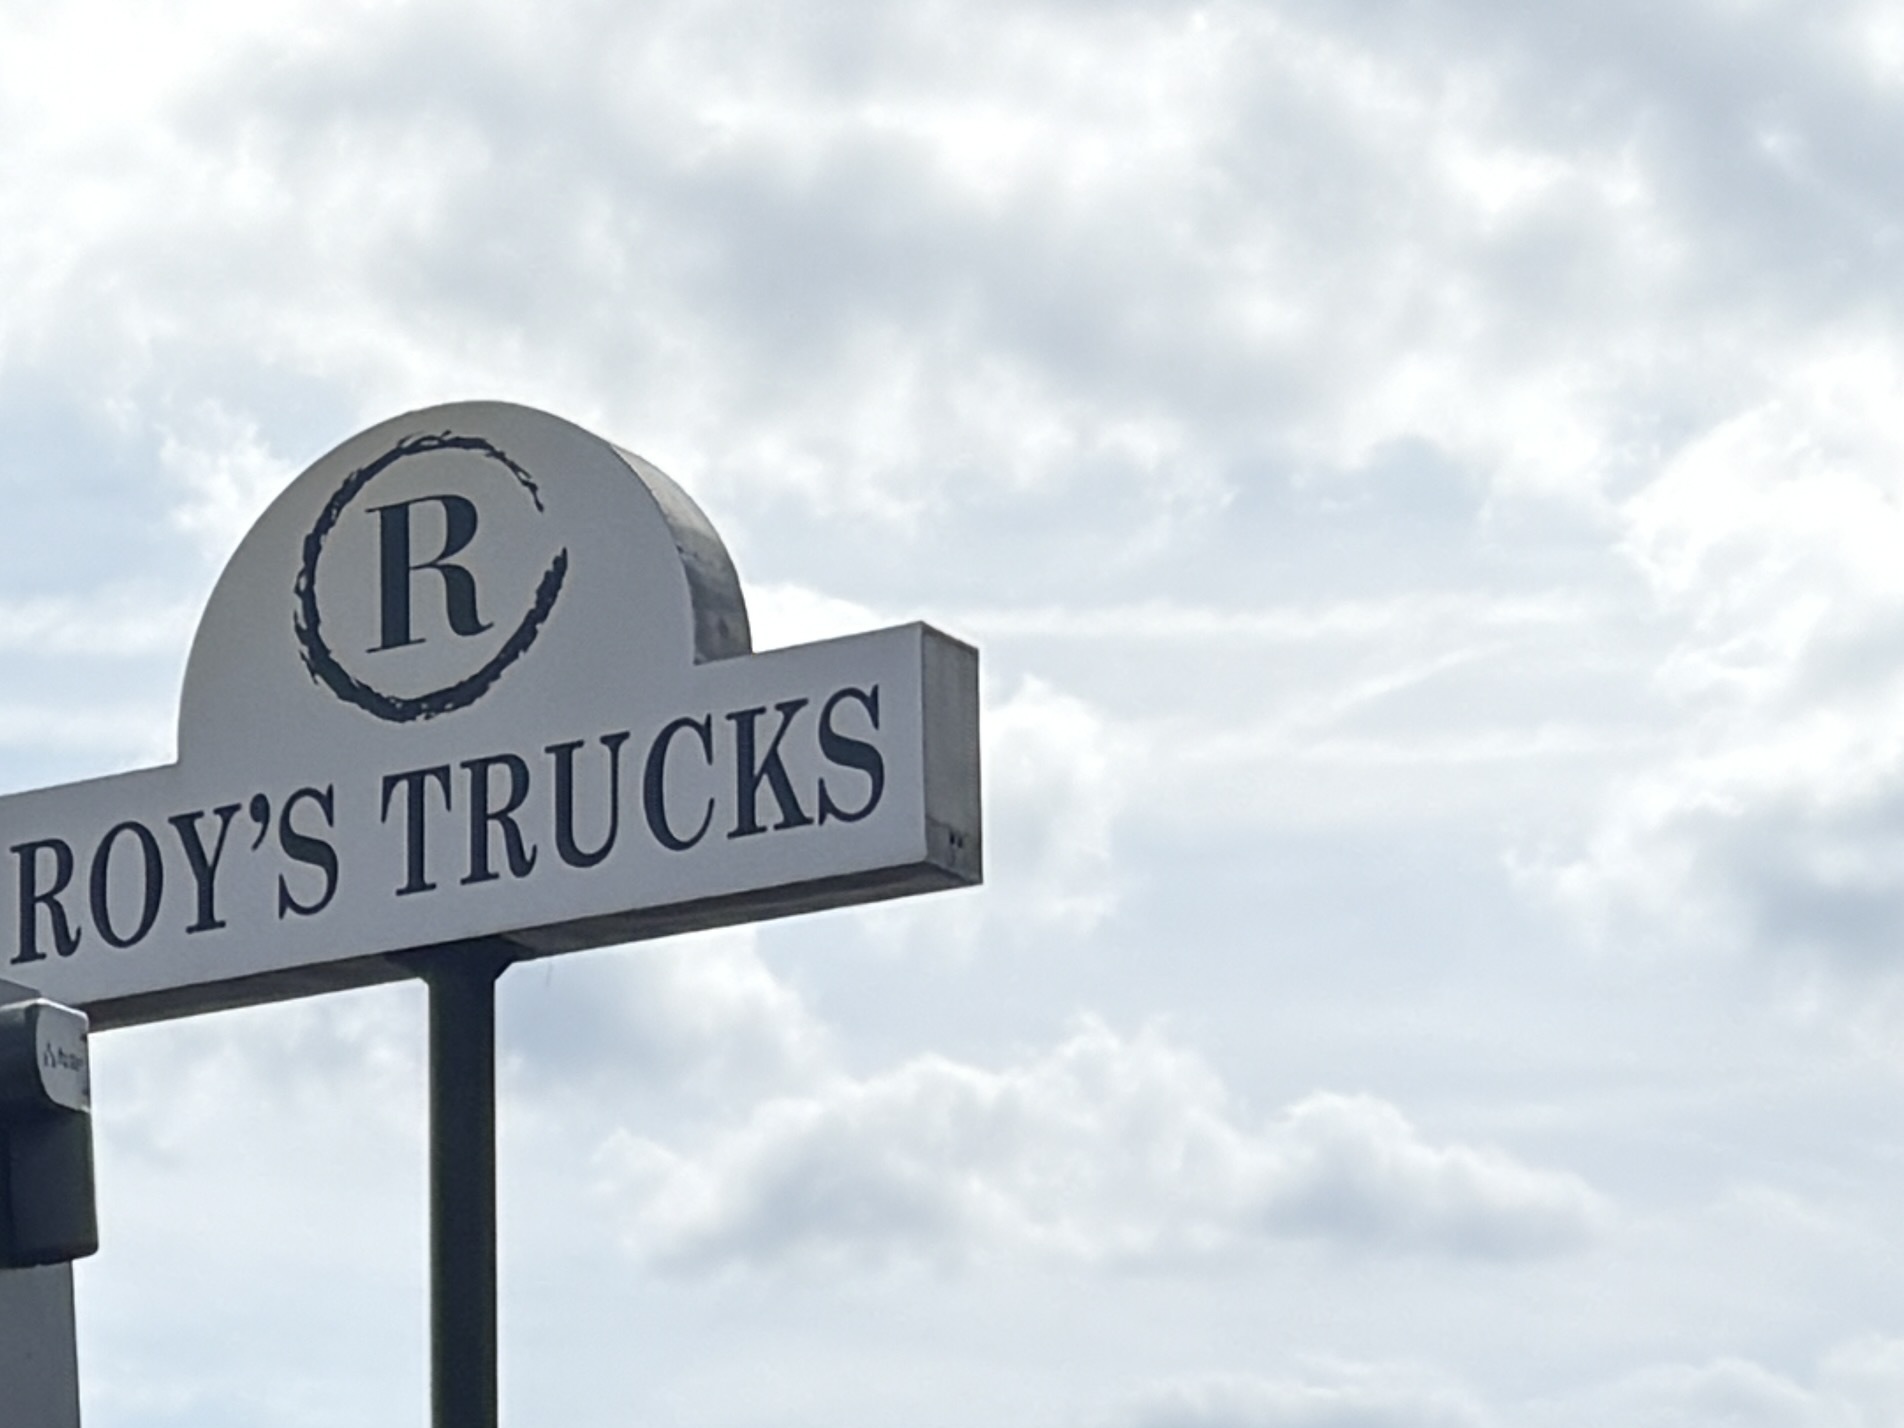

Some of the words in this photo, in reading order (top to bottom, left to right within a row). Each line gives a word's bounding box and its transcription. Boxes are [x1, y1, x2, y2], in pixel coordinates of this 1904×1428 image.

[365, 494, 494, 654] R
[10, 784, 340, 965] ROY'S
[381, 683, 886, 897] TRUCKS
